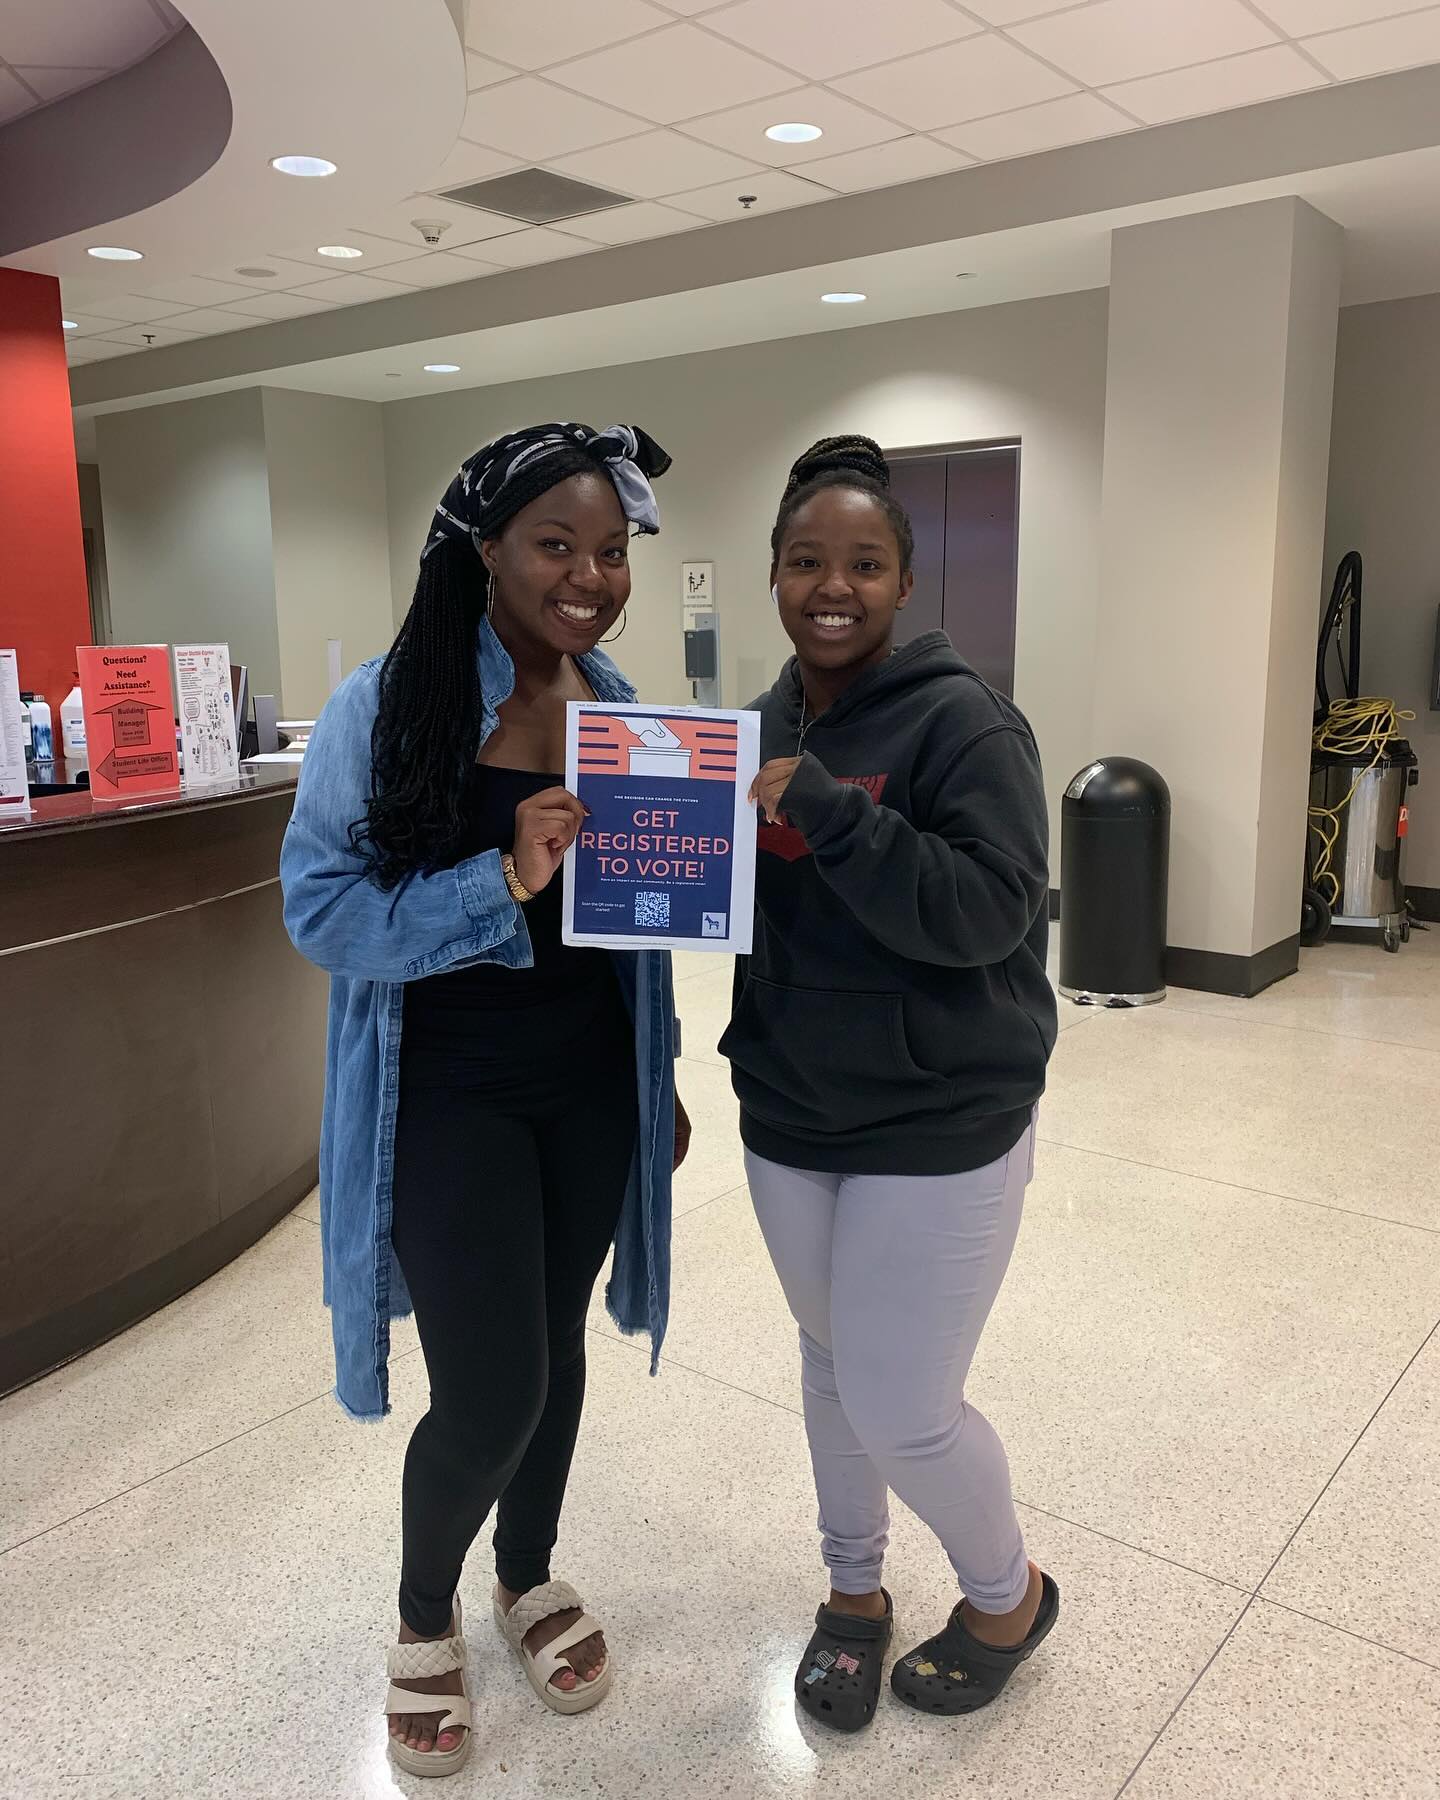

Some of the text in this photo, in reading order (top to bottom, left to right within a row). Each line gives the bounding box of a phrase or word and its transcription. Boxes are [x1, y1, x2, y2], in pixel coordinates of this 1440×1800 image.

[102, 655, 147, 666] Questions?
[116, 670, 136, 678] Need
[104, 680, 150, 690] Assistance?
[632, 810, 680, 828] GET
[580, 832, 730, 855] REGISTERED
[597, 857, 704, 878] TO VOTE!
